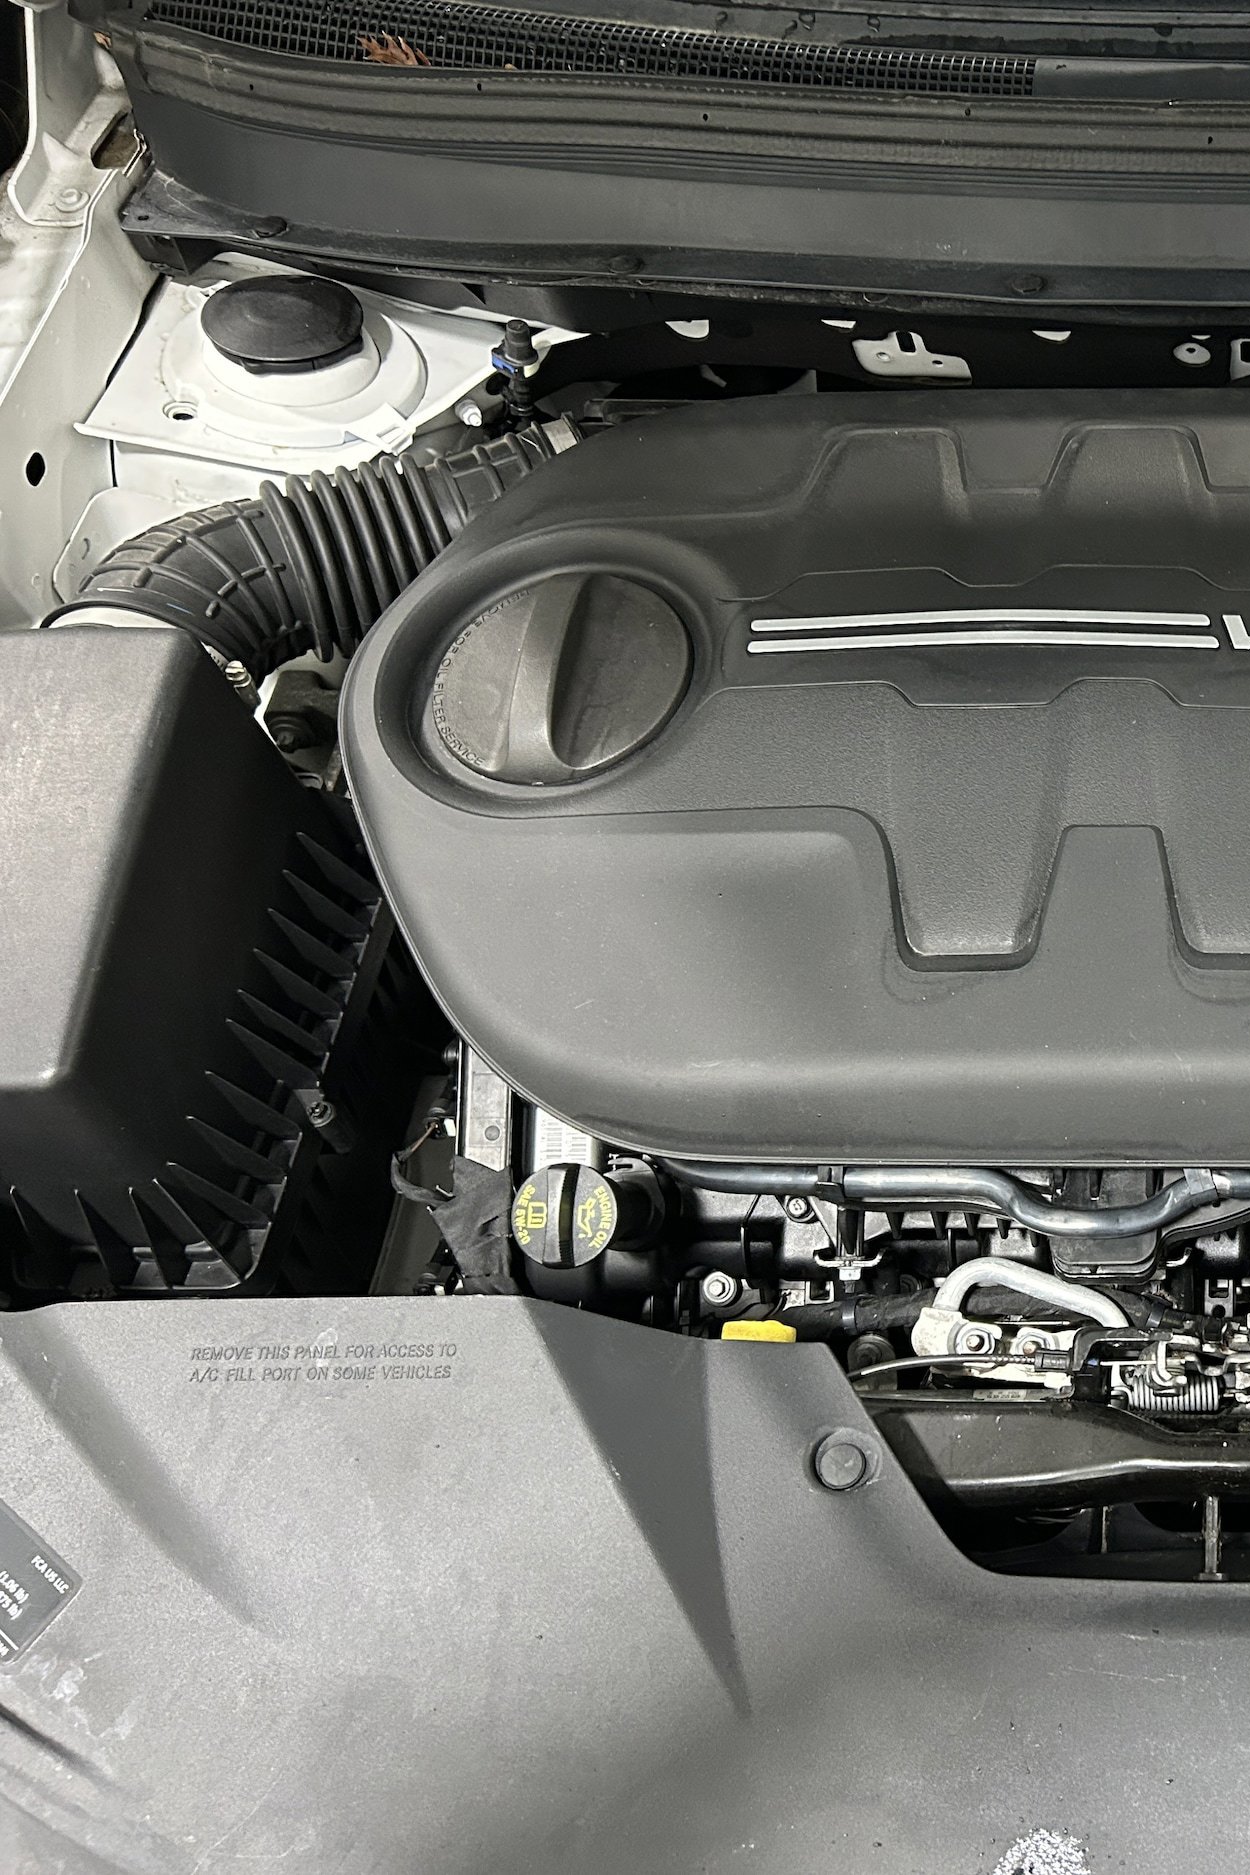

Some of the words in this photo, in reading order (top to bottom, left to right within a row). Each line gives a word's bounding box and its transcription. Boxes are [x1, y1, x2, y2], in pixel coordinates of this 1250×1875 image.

[452, 630, 472, 655] FOR
[436, 657, 452, 679] OIL
[432, 682, 446, 725] FILTER
[440, 725, 486, 767] SERVICE
[517, 1184, 536, 1208] SAE
[594, 1186, 612, 1230] ENGINE
[514, 1209, 531, 1245] 5W-20
[588, 1230, 608, 1249] OIL
[190, 1346, 254, 1361] REMOVE
[257, 1346, 290, 1361] THIS
[293, 1344, 341, 1360] PANEL
[341, 1343, 375, 1359] FOR
[376, 1343, 434, 1359] ACCESS
[438, 1343, 458, 1357] TO
[189, 1366, 218, 1383] A/C
[226, 1367, 256, 1382] FILL
[261, 1366, 302, 1382] PORT
[306, 1366, 330, 1381] ON
[332, 1364, 376, 1381] SOME
[380, 1364, 452, 1380] VEHICLES
[30, 1554, 48, 1574] FCA
[43, 1567, 59, 1584] US
[52, 1576, 70, 1595] LLC
[13, 1586, 30, 1605] lb)
